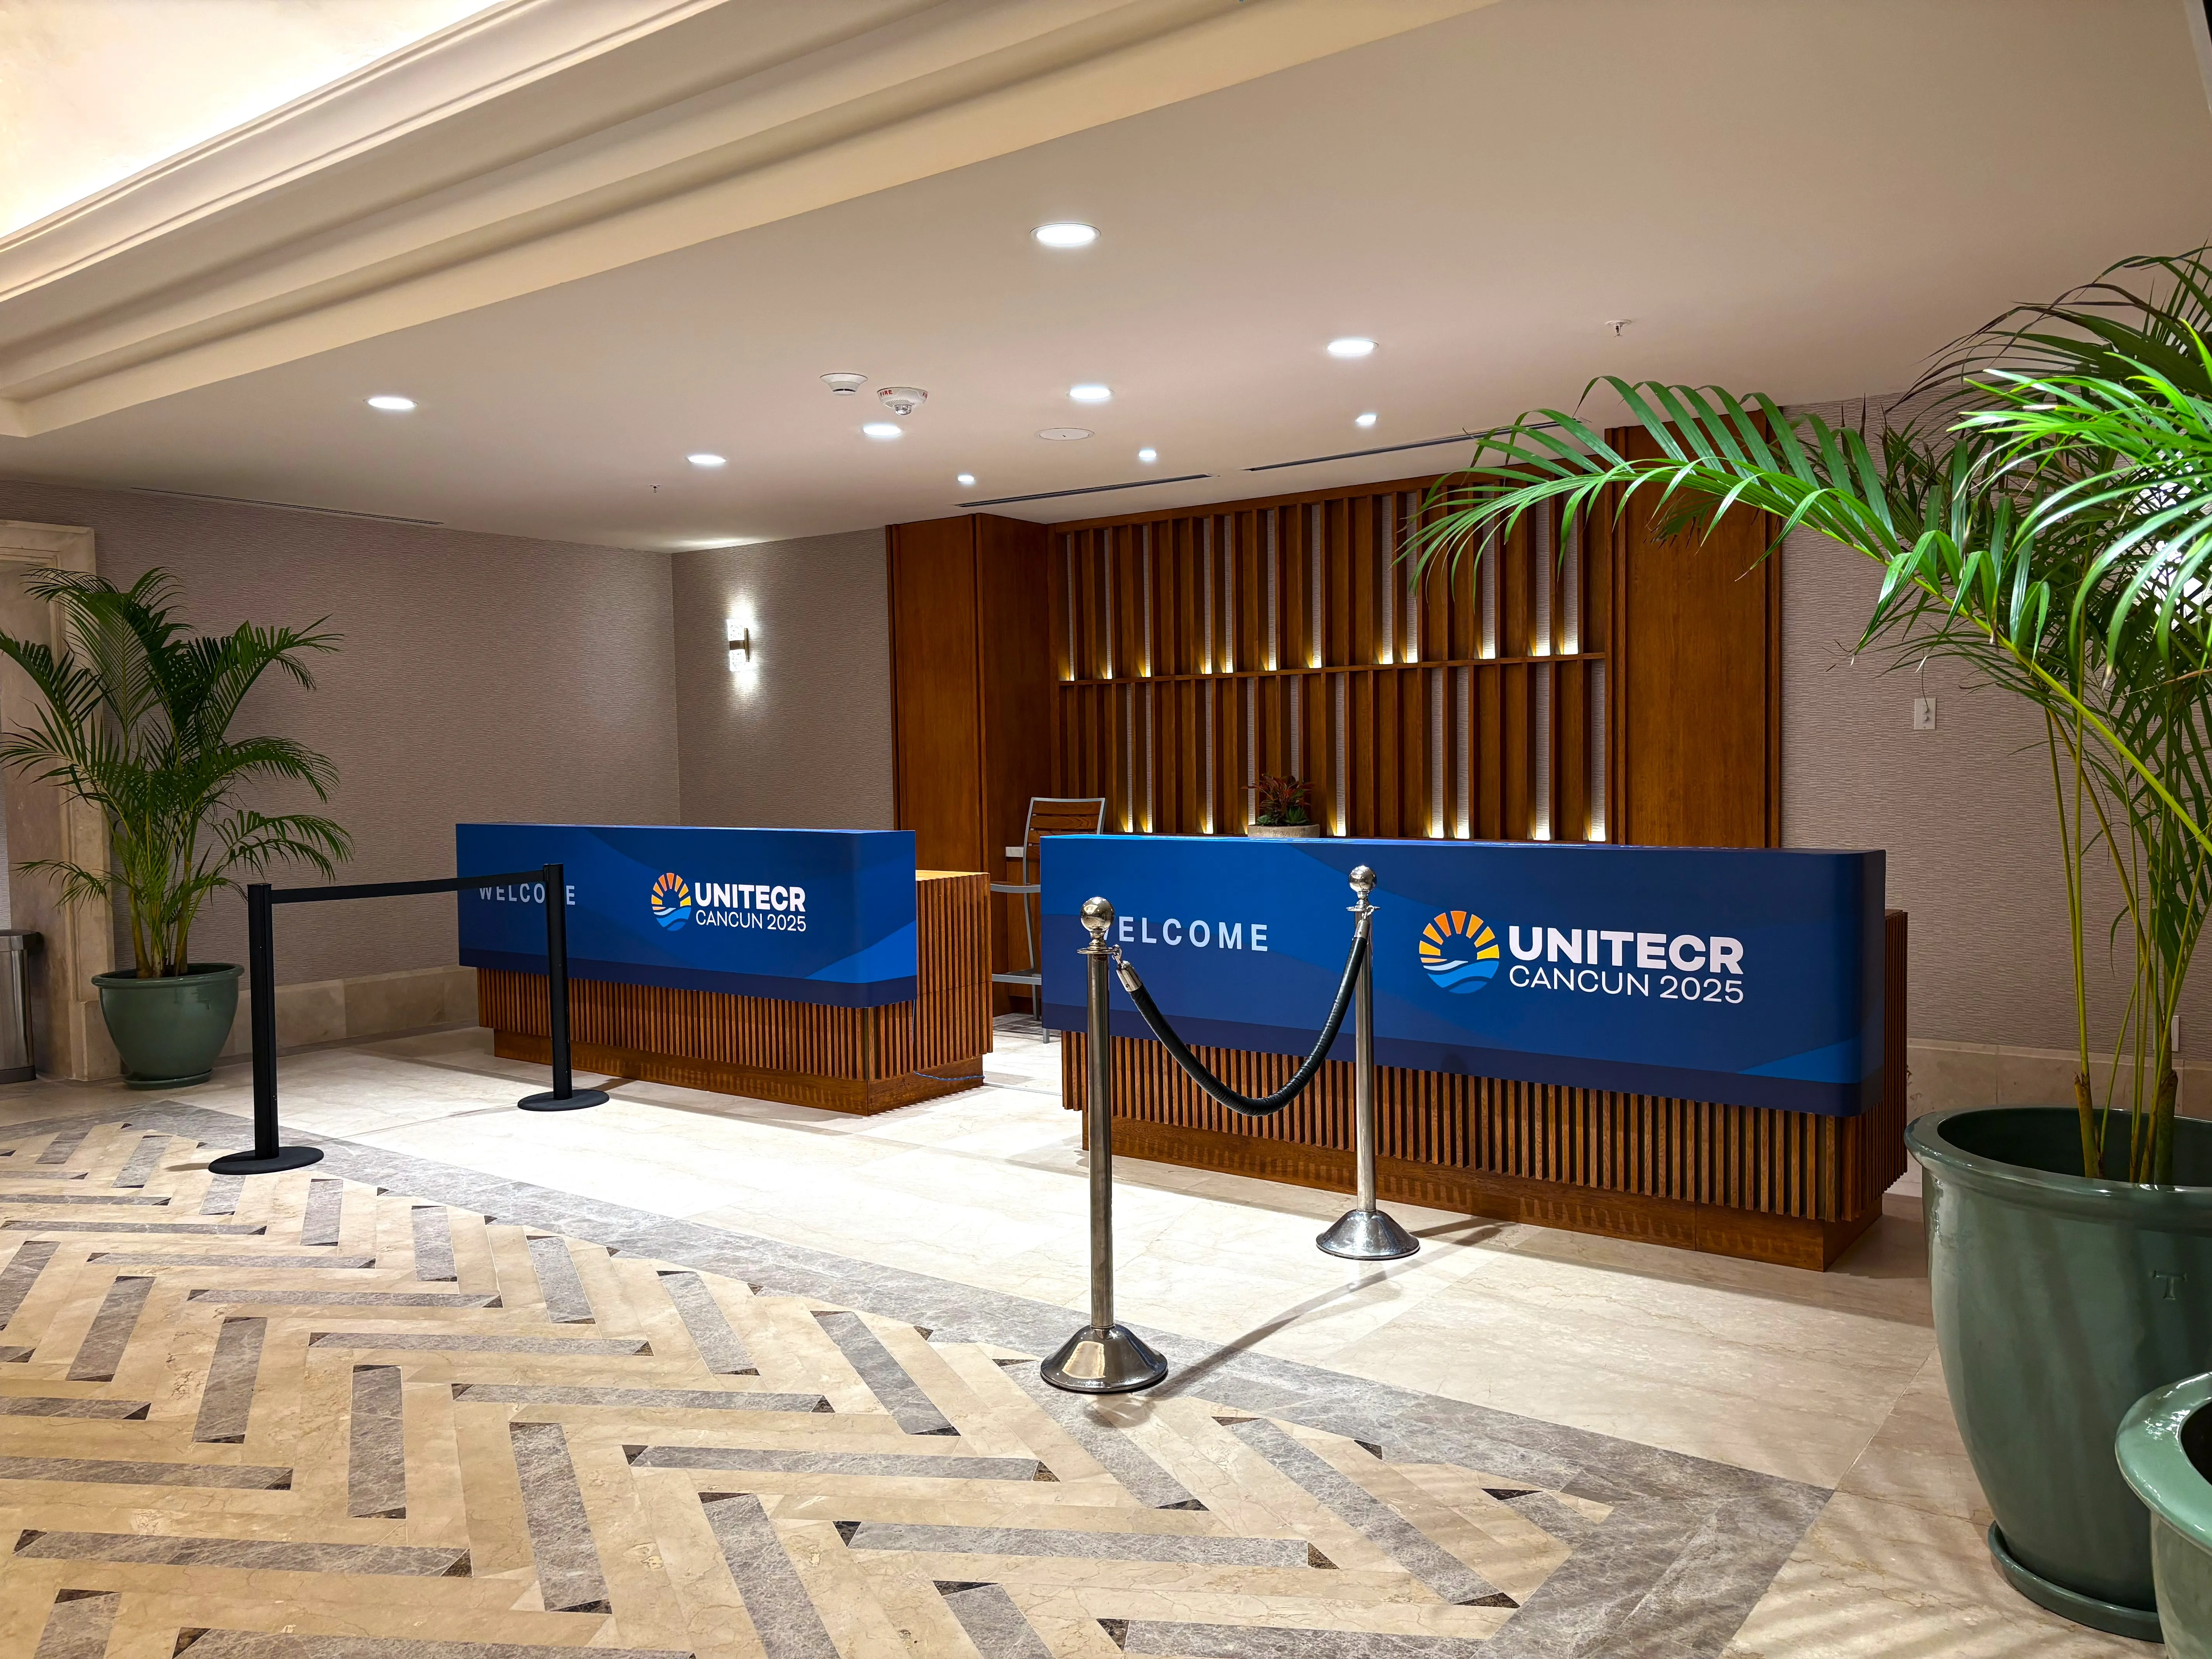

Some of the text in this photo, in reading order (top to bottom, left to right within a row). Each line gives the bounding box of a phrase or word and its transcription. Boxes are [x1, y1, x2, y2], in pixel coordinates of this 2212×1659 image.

[479, 883, 575, 905] WELCOE
[695, 882, 806, 912] UNITECR
[696, 910, 807, 932] CANCUN 2025
[1090, 916, 1268, 952] ELCOME
[1509, 926, 1744, 975] UNITECR
[1510, 965, 1744, 1004] CANCUN 2025
